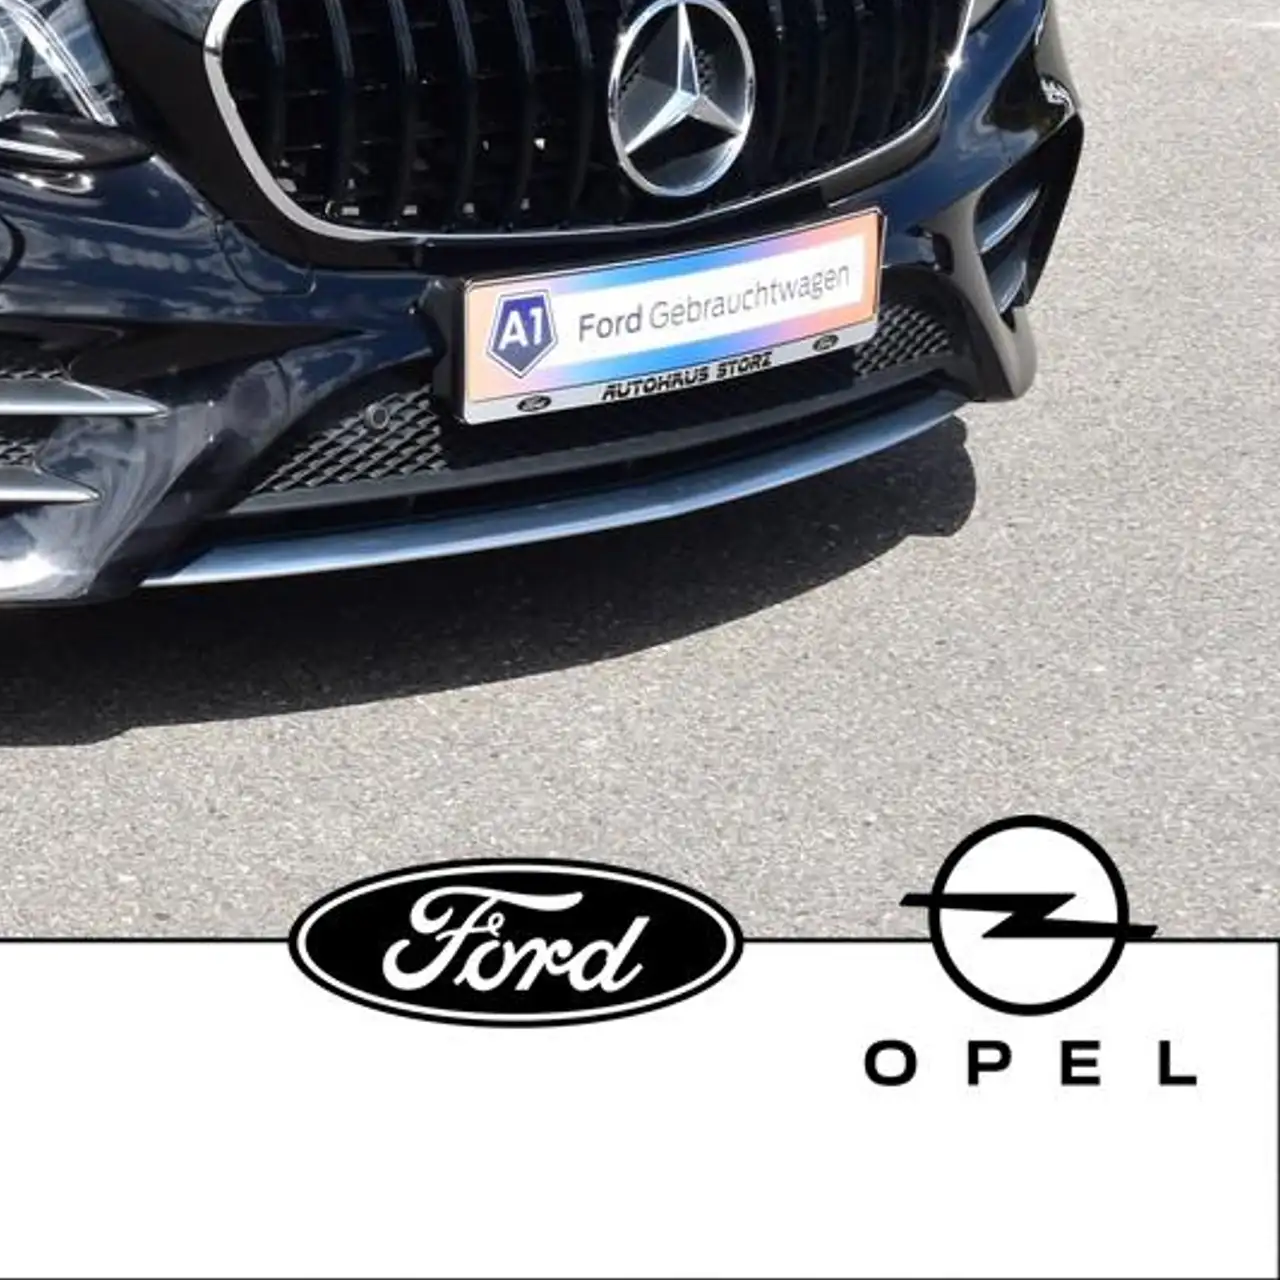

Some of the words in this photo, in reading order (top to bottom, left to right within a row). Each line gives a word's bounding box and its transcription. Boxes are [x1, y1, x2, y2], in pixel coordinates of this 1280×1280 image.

[578, 305, 642, 343] Ford
[648, 263, 851, 330] Gebrauchtwagen
[497, 305, 545, 352] A1
[602, 366, 710, 400] AUTOHAUS
[716, 352, 773, 378] STORZ
